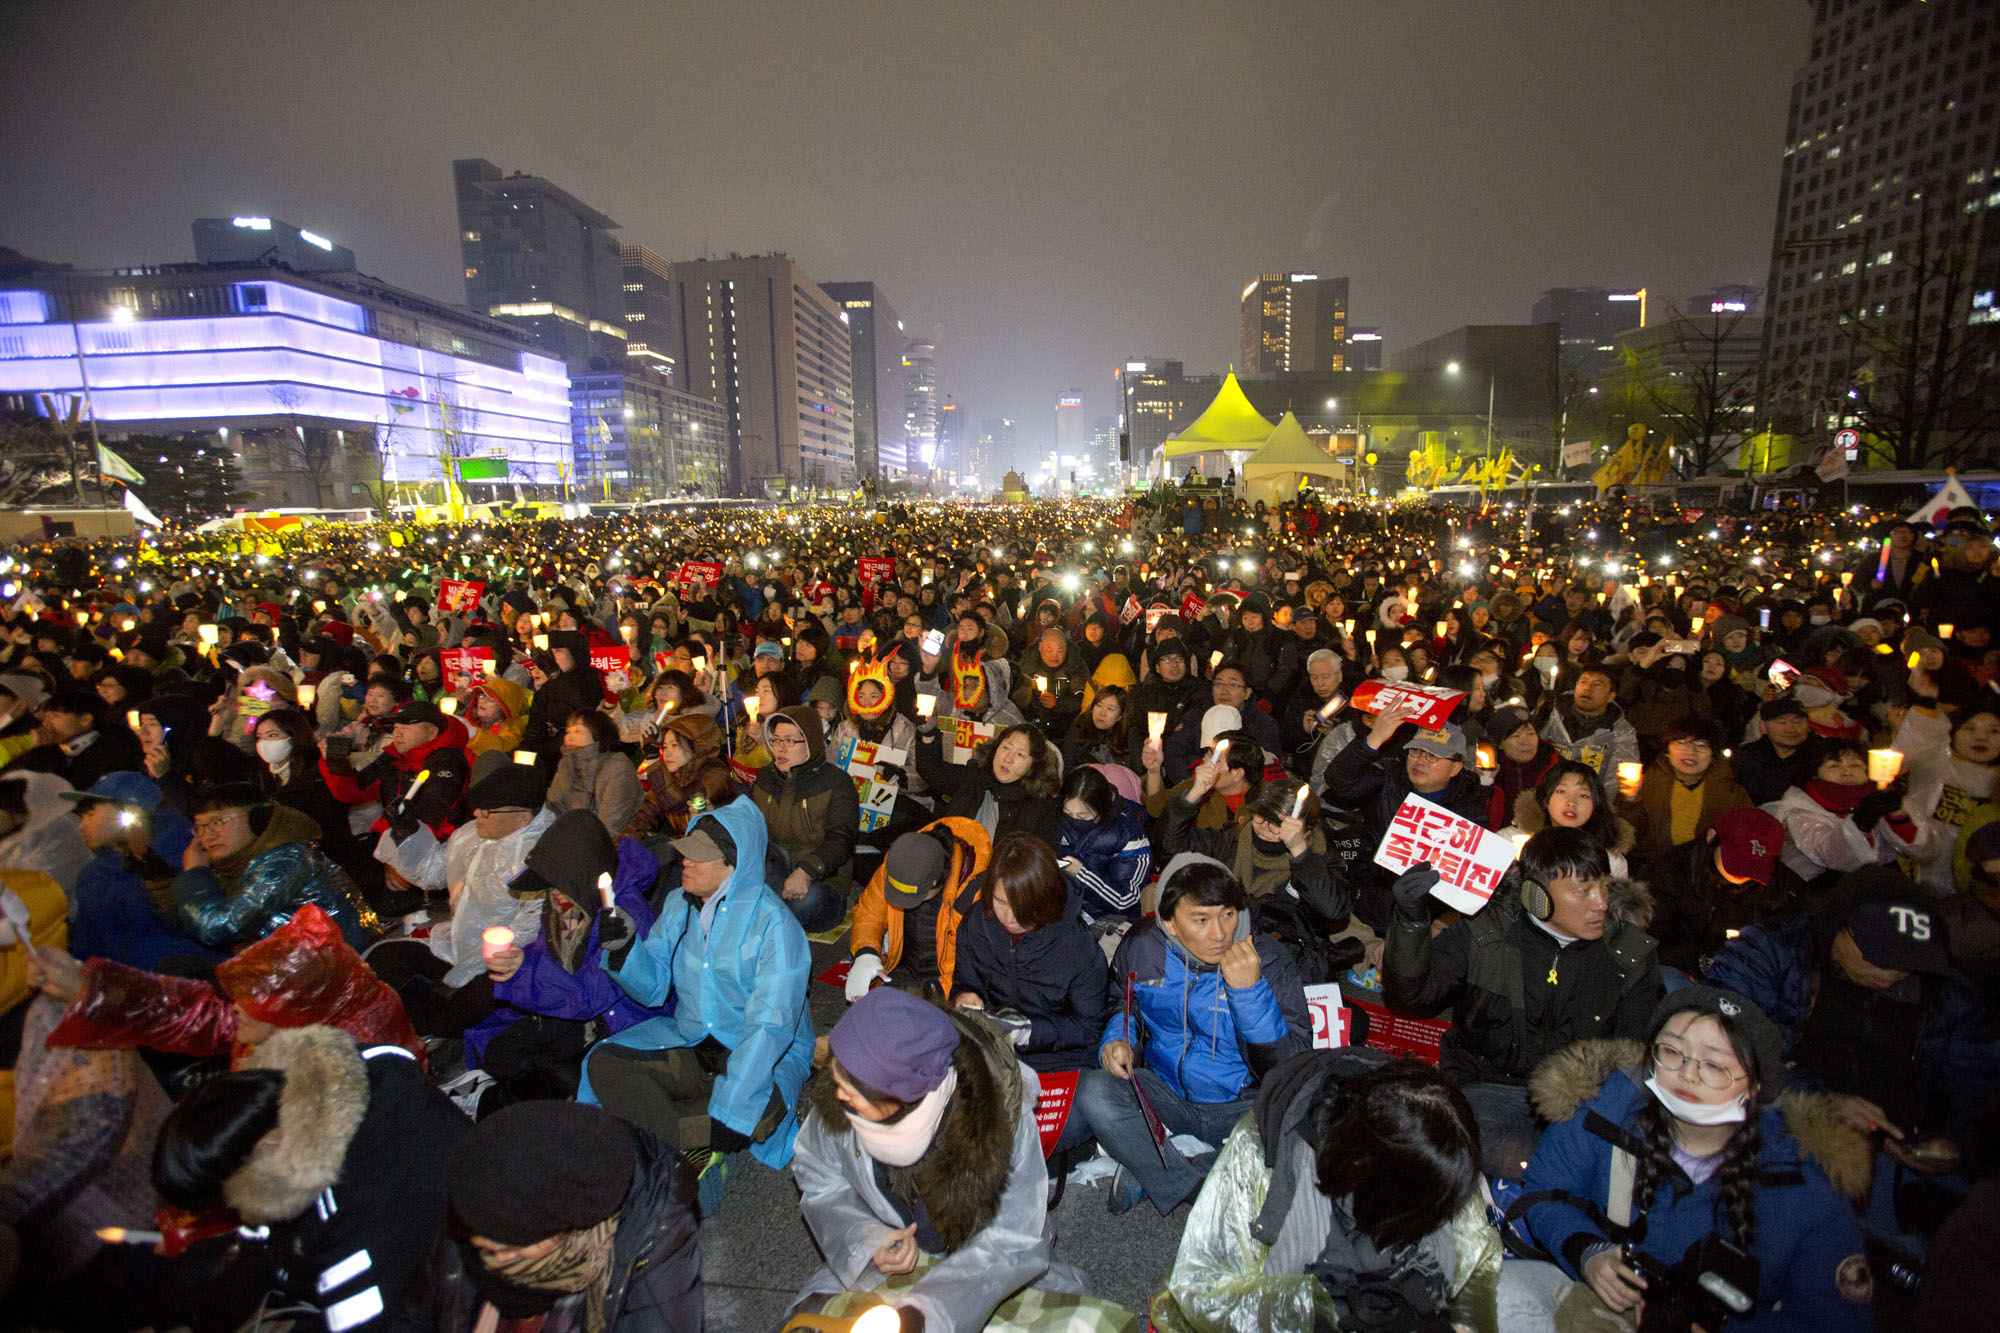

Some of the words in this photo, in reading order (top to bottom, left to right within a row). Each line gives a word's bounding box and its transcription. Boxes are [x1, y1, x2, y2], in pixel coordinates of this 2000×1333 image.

[1394, 803, 1485, 855] 박근혜
[1385, 832, 1502, 900] 즉각퇴진
[1889, 906, 1931, 941] TS
